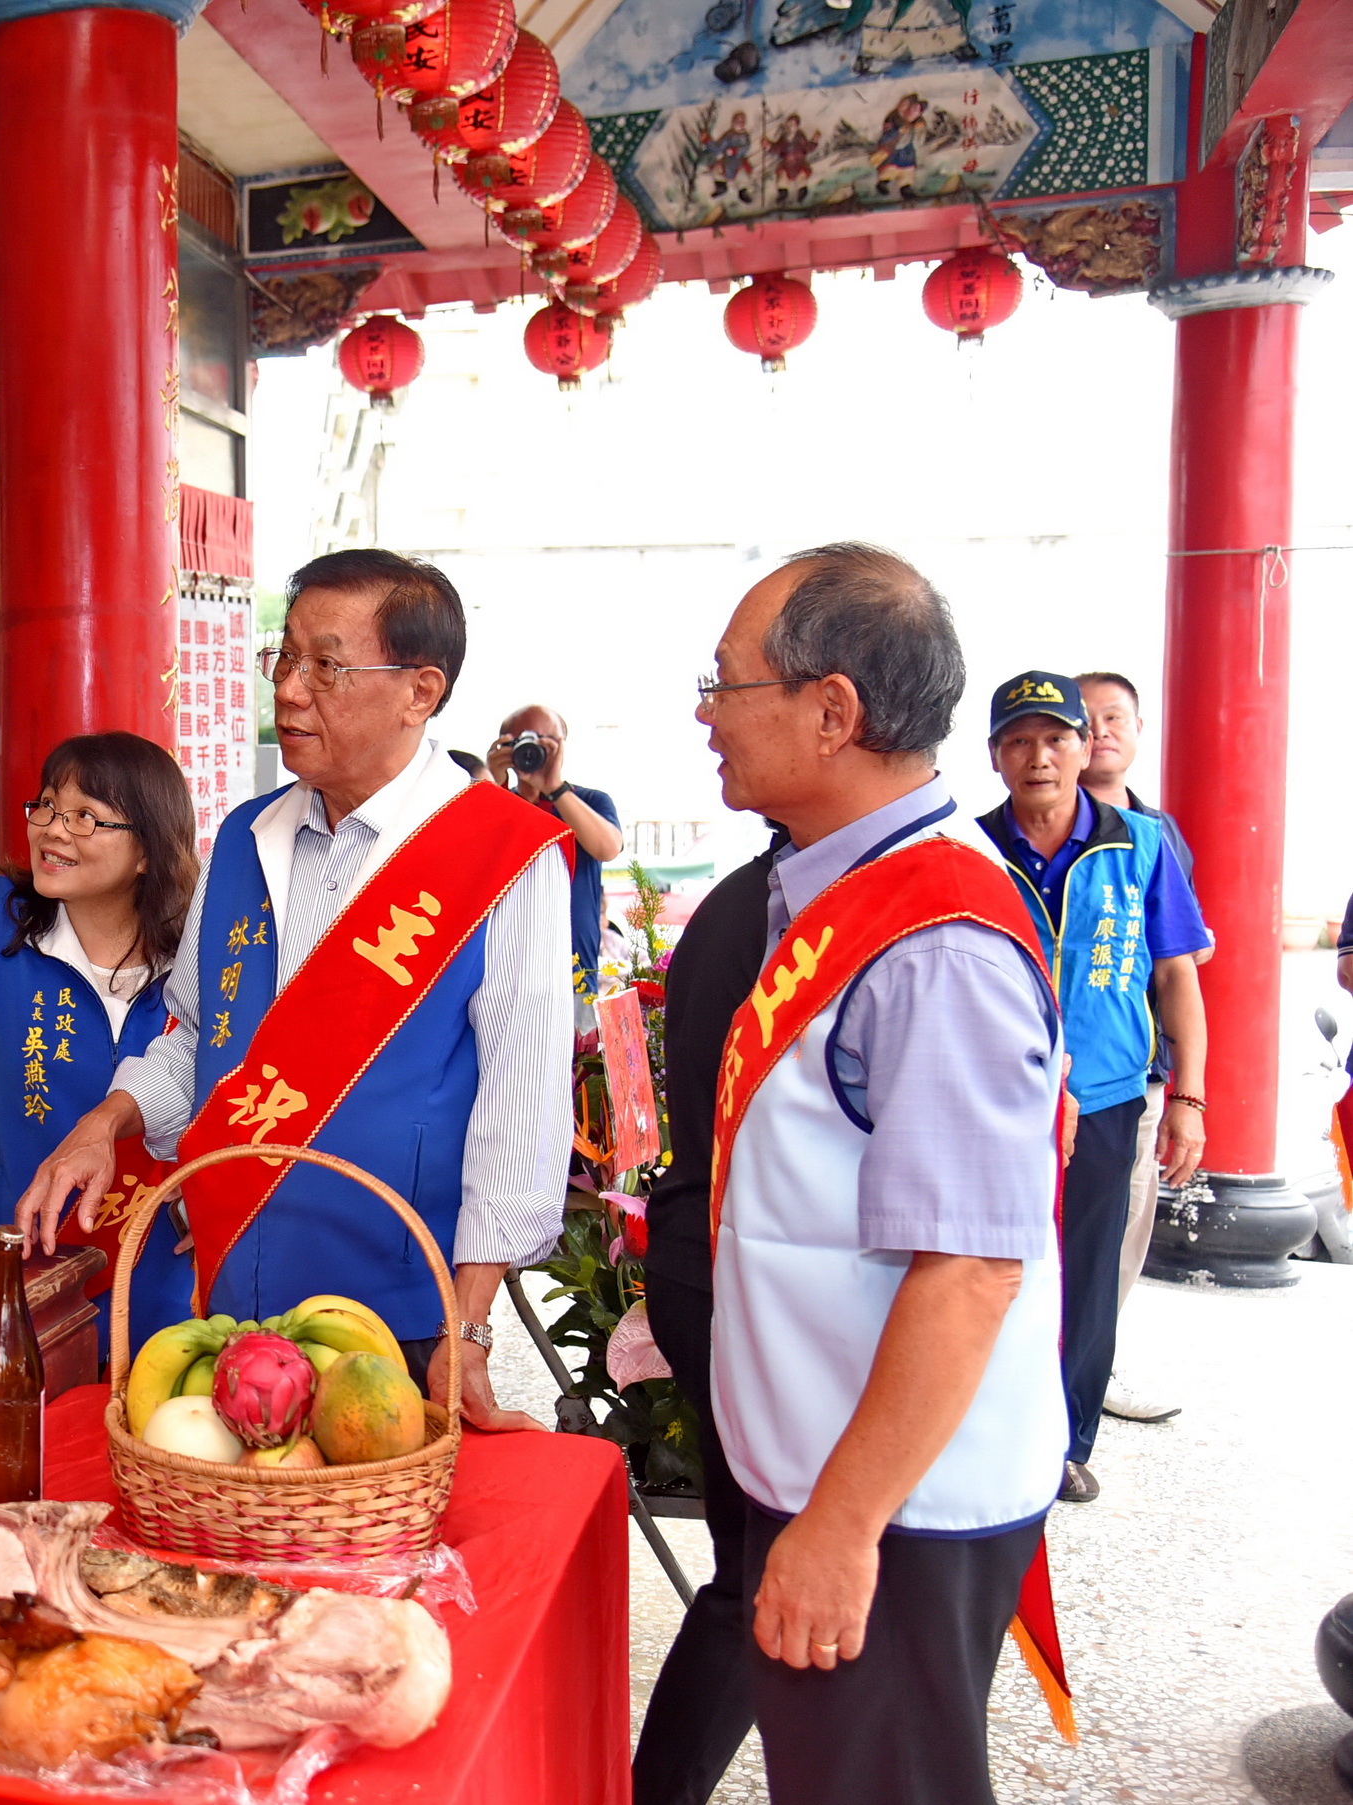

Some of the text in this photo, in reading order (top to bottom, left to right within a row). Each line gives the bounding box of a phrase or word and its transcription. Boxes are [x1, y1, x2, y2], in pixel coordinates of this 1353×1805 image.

[212, 623, 228, 829] 地方首長、民意代
[52, 987, 77, 1063] 民政處
